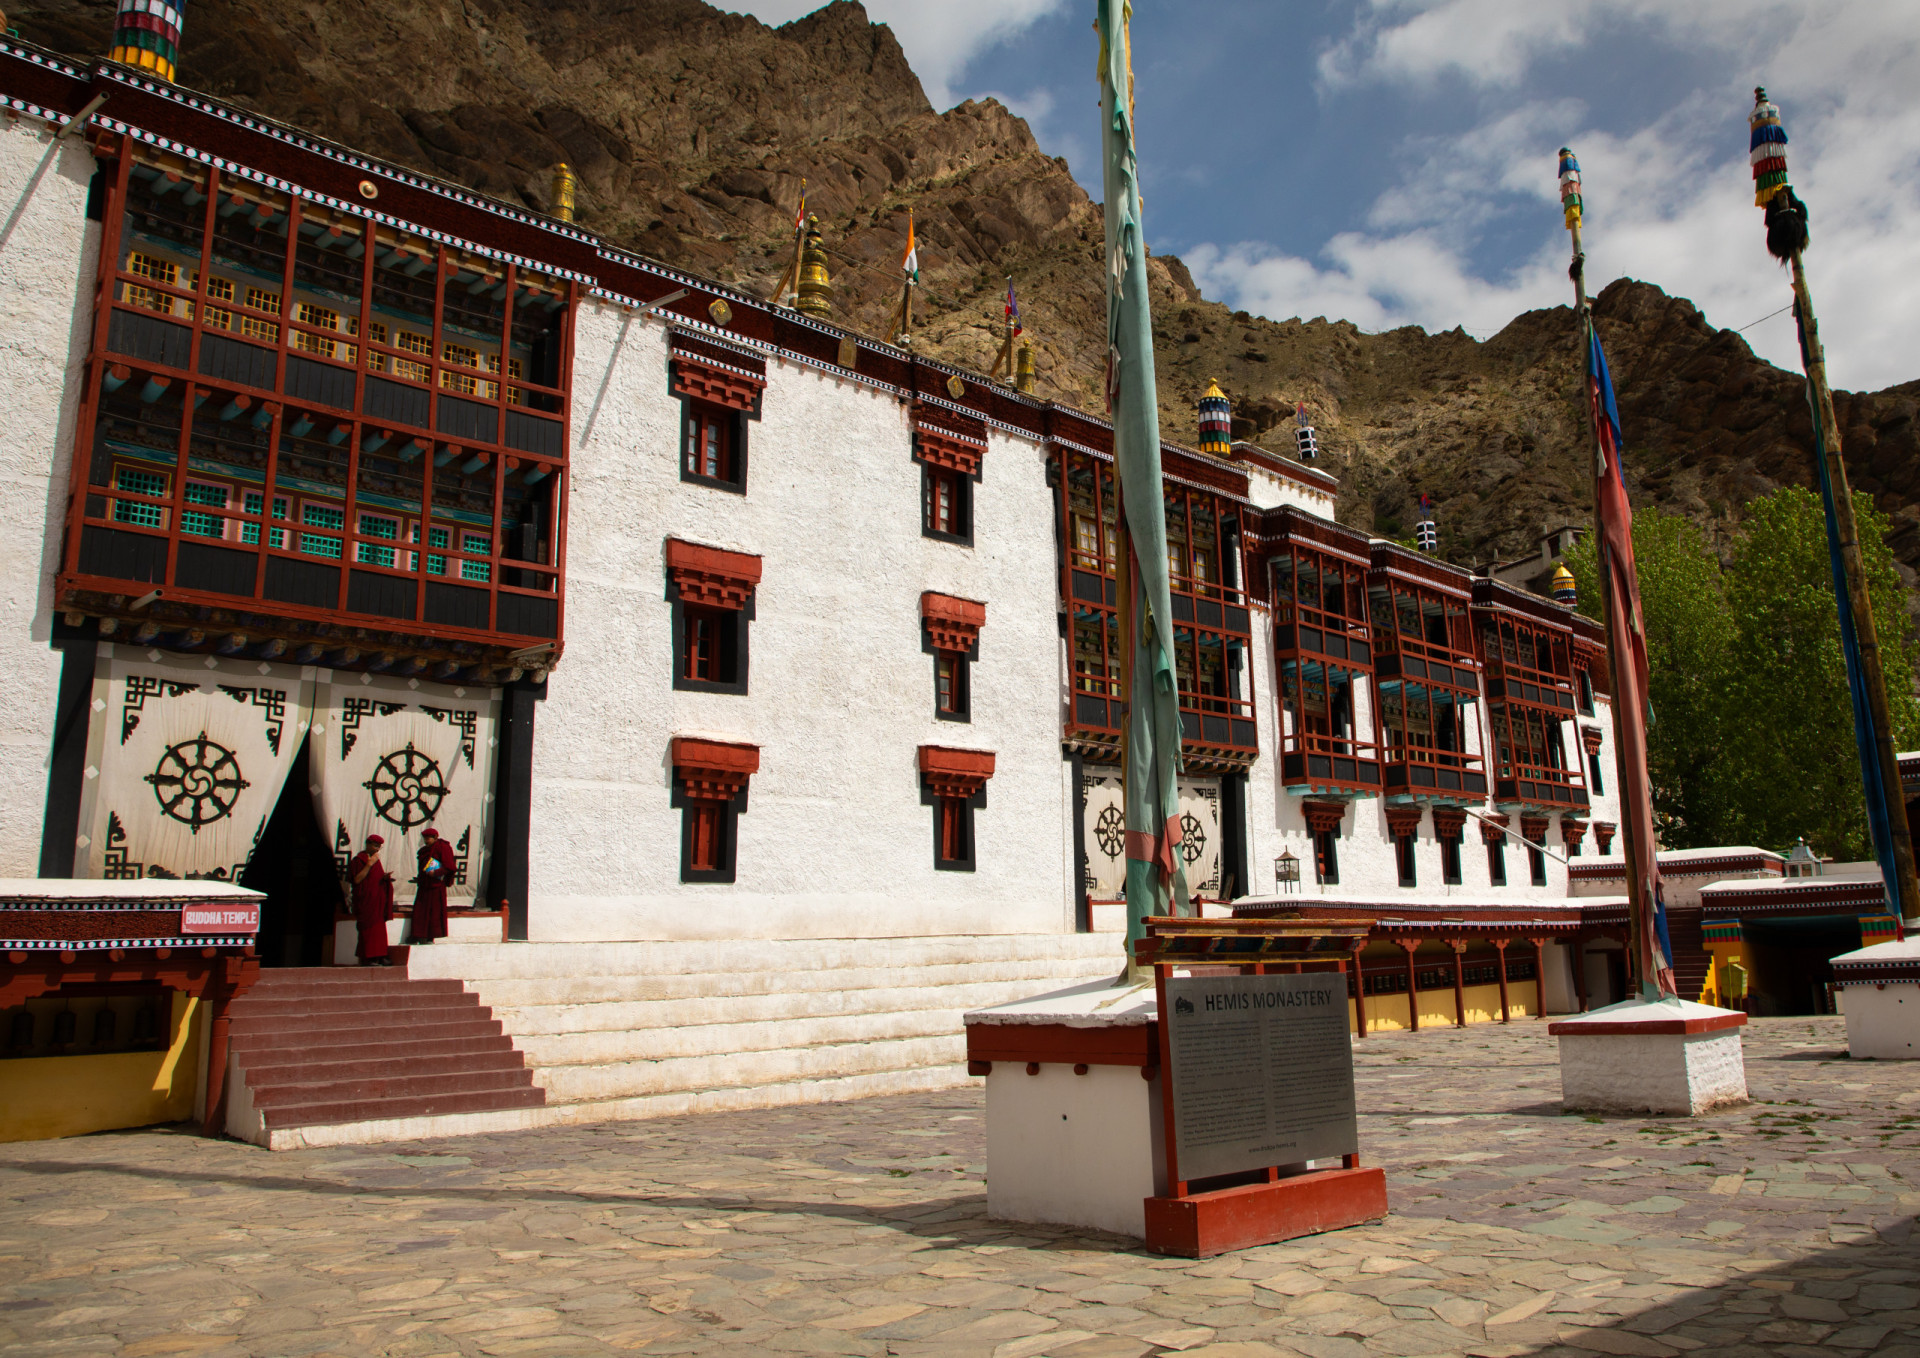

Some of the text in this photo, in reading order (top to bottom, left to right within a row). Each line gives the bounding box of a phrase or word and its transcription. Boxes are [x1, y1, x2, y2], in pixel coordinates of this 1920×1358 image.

[186, 911, 257, 925] BUDDHA TEMPLE
[1205, 990, 1332, 1011] HEMIS MONASTERY
